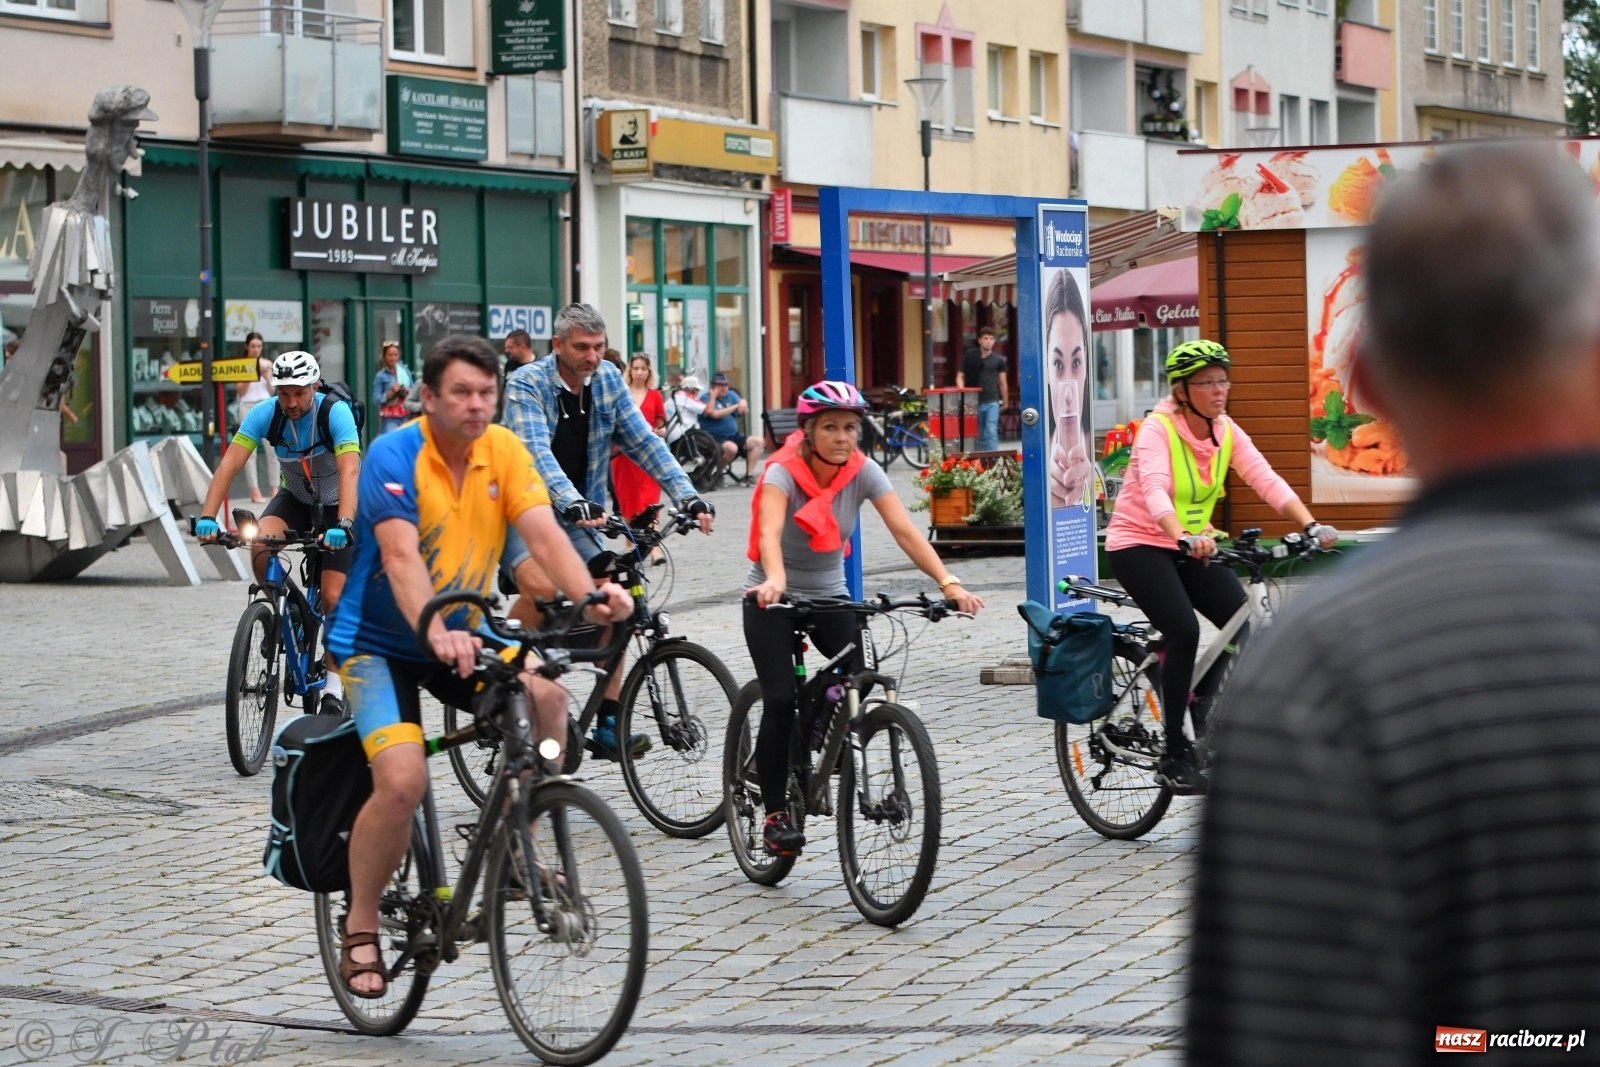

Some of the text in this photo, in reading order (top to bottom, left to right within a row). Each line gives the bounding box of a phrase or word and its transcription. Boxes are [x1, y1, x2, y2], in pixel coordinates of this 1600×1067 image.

[623, 150, 646, 158] KASY
[292, 201, 438, 245] JUBILER
[1055, 230, 1083, 246] Wodociągi
[327, 249, 354, 264] 1989
[1056, 245, 1083, 258] Raciborskie
[150, 300, 171, 315] Pierre
[1095, 308, 1112, 323] Ciao
[1114, 306, 1135, 321] Italia
[489, 308, 545, 334] CASIO
[179, 365, 247, 377] JADŁDAJNIA
